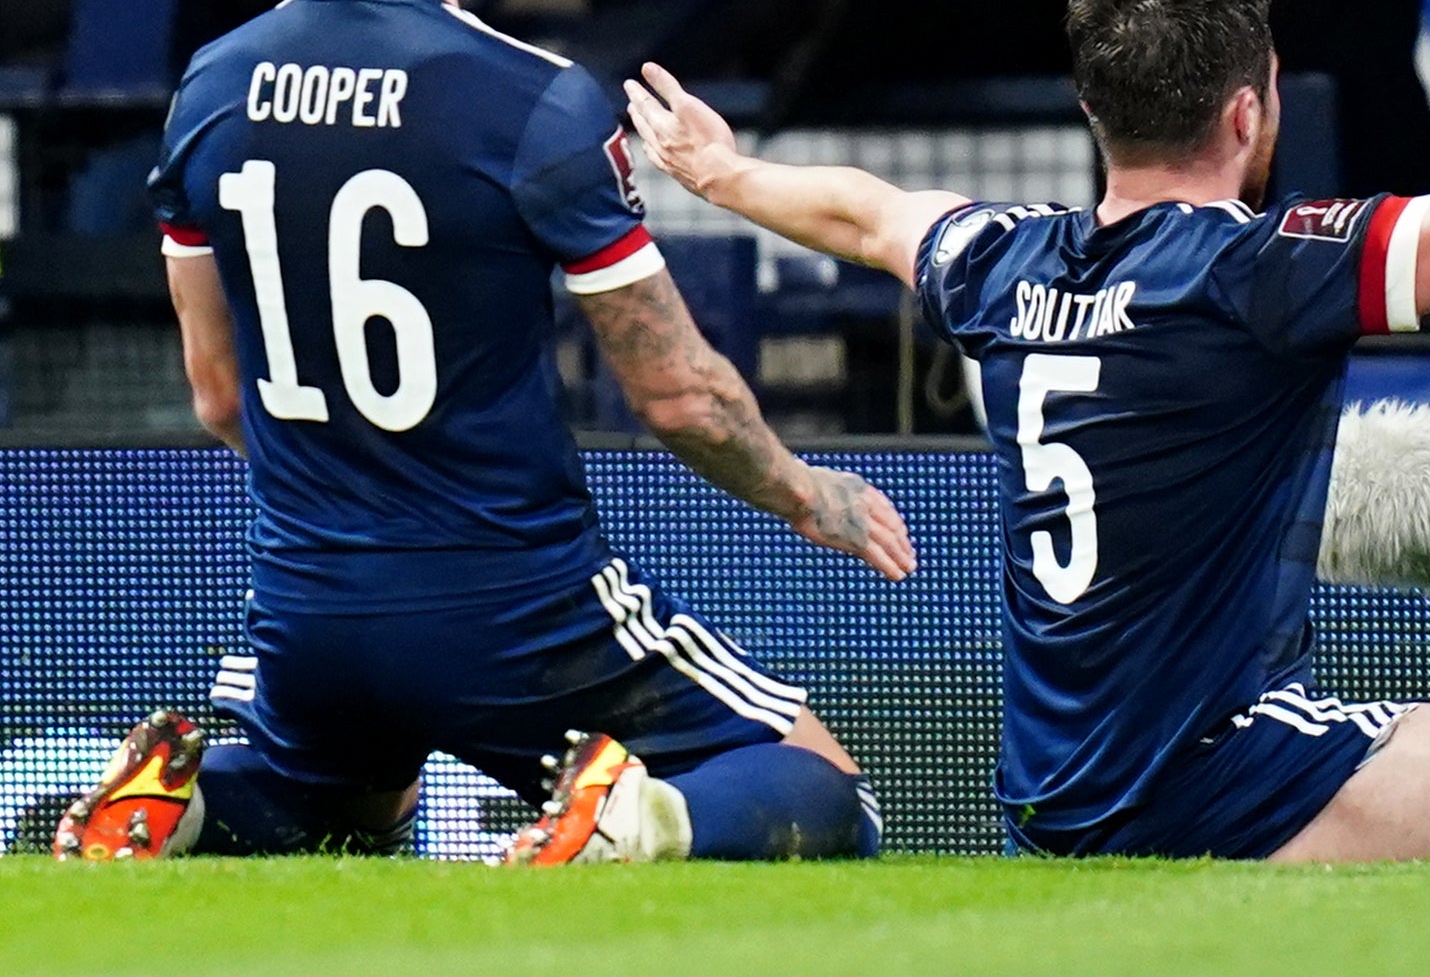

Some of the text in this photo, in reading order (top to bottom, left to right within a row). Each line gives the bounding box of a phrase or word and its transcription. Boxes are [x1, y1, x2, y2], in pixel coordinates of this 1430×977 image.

[246, 61, 408, 128] COOPER
[219, 159, 438, 432] 16
[1009, 279, 1137, 343] SOUTTAR
[1016, 352, 1101, 605] 5
